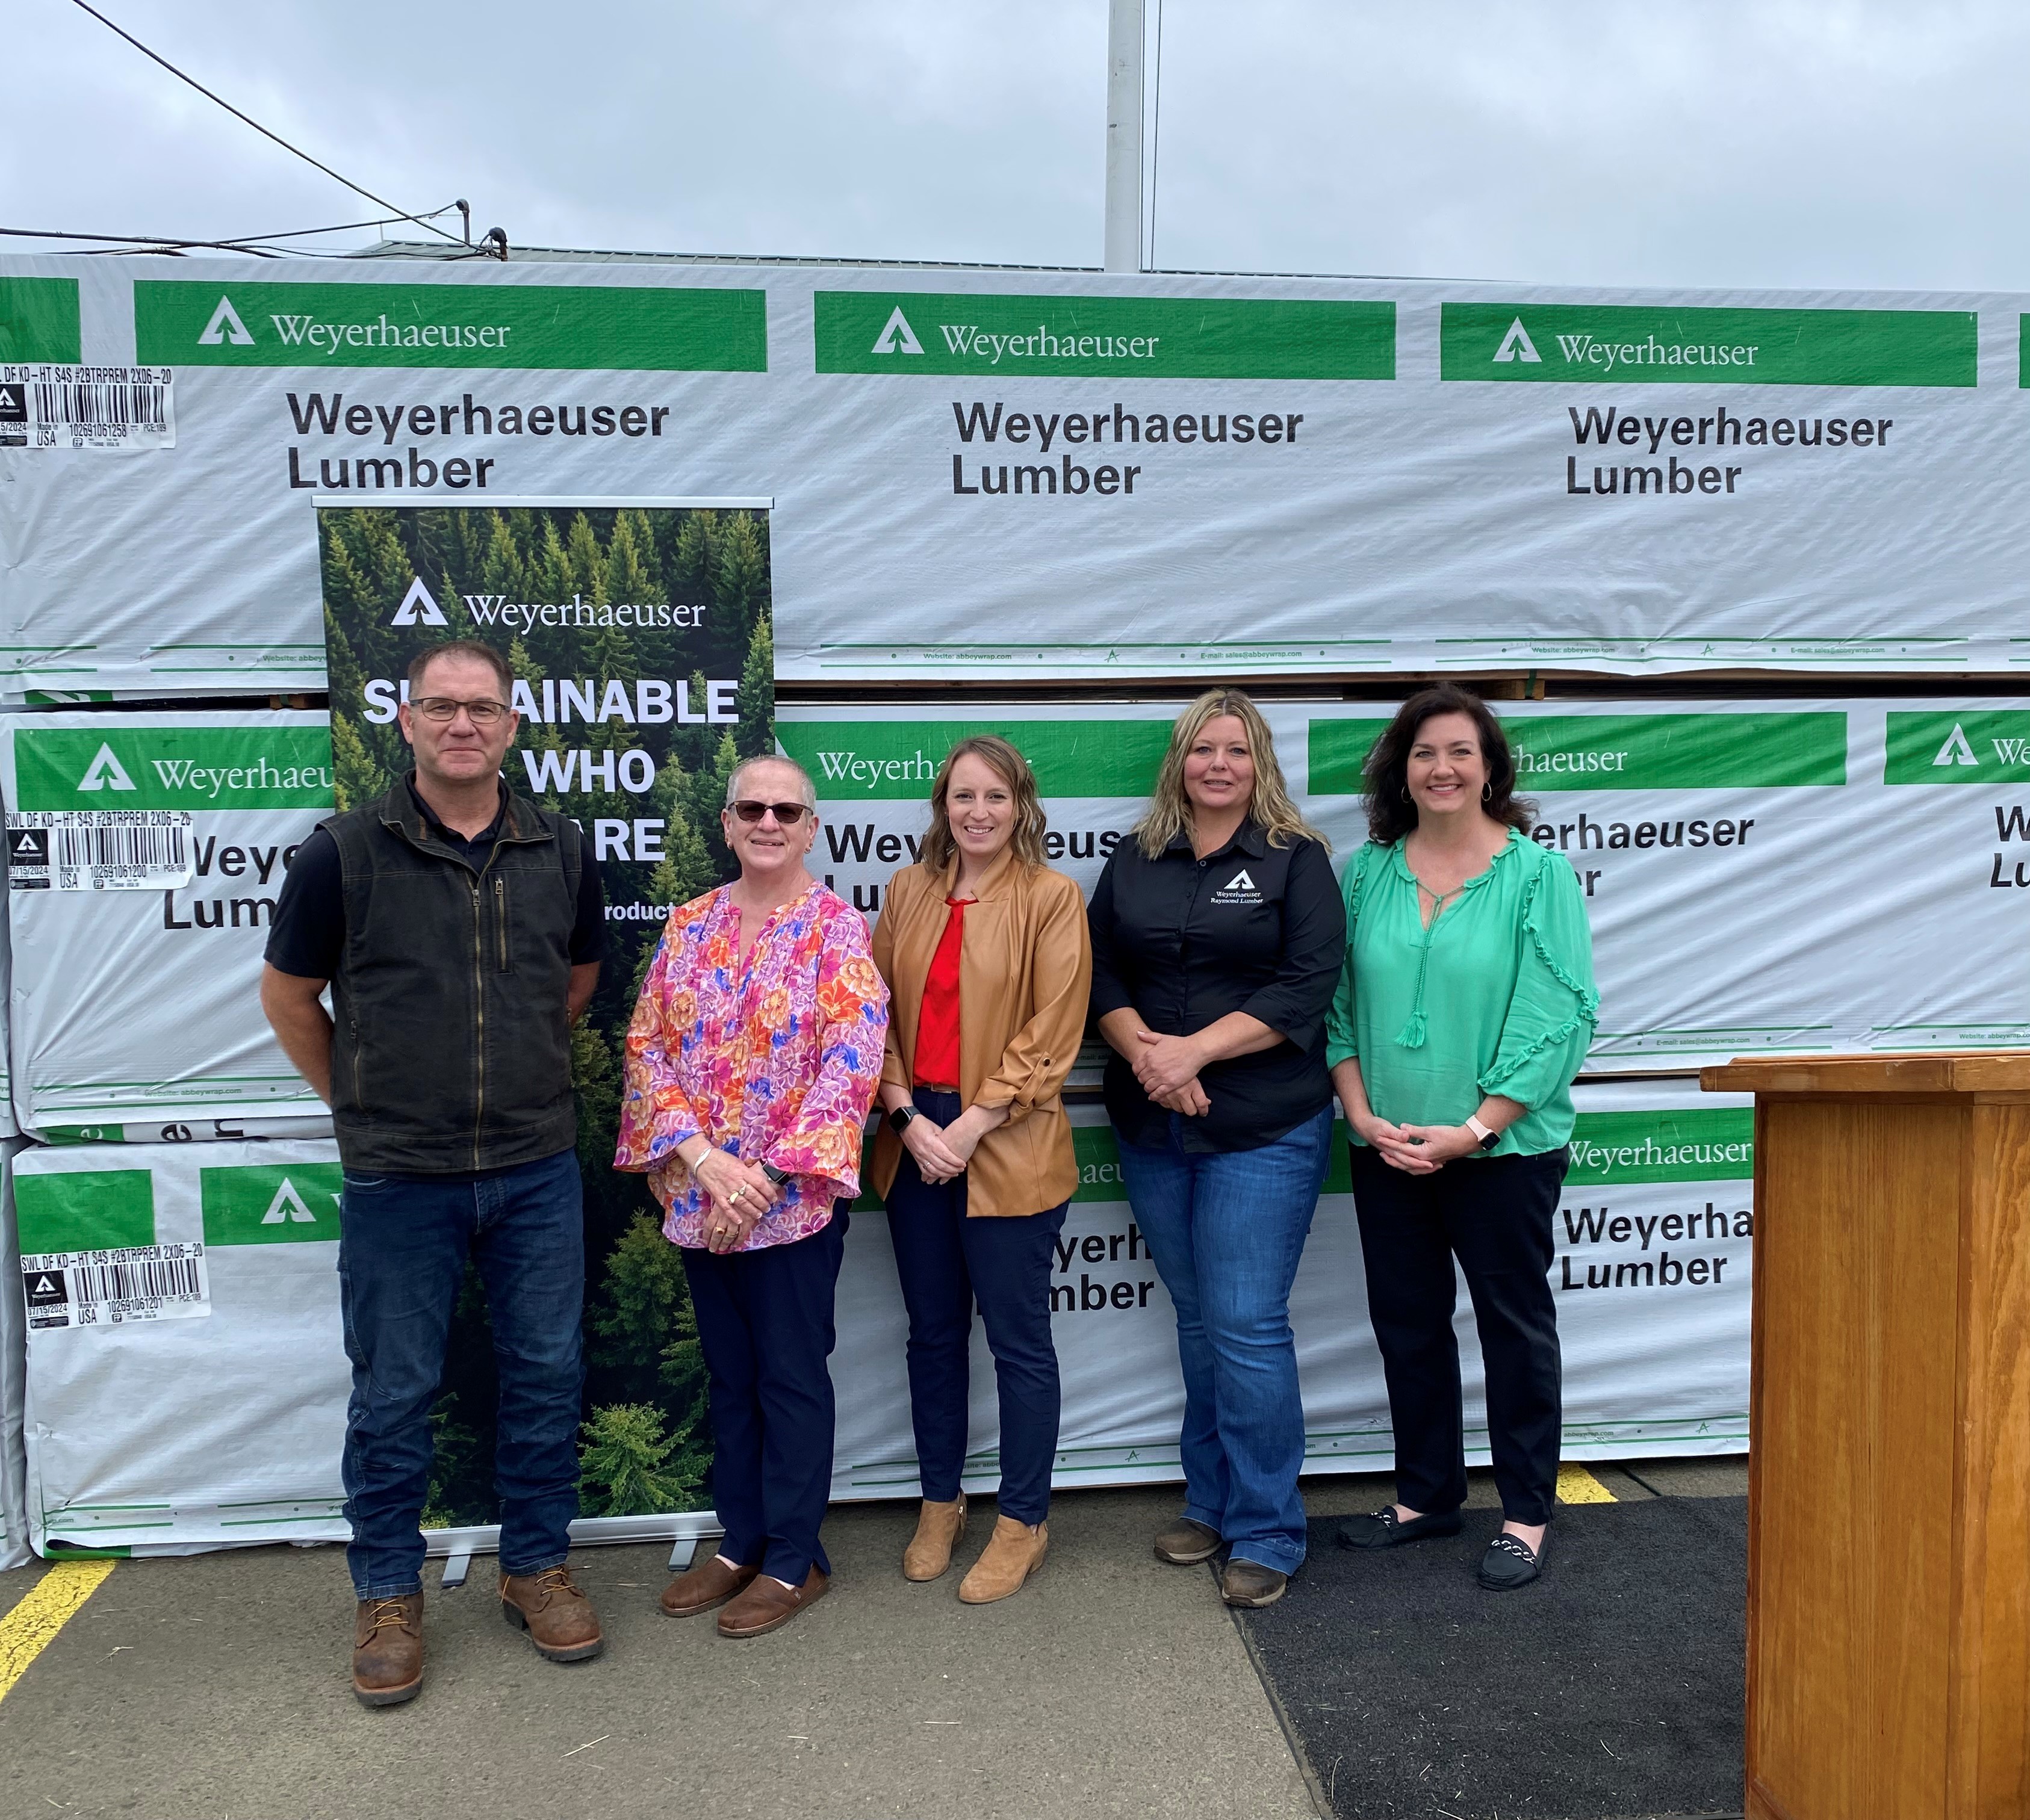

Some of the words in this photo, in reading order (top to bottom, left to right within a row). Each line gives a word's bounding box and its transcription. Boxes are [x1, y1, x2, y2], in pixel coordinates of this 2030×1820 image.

[270, 314, 511, 355] Weyerhaeuser
[939, 323, 1159, 365] Weyerhaeuser
[1556, 332, 1758, 373] Weyerhaeuser
[4, 366, 16, 382] DF
[55, 366, 72, 383] S4S
[75, 367, 128, 384] #2BTRPREM
[69, 423, 126, 437] 102691061258
[286, 392, 670, 445] Weyerhaeuser
[952, 402, 1304, 453] Weyerhaeuser
[1568, 406, 1894, 454] Weyerhaeuser
[37, 431, 57, 446] USA
[288, 447, 494, 489] Lumber
[952, 454, 1141, 495] Lumber
[1566, 456, 1742, 495] Lumber
[463, 593, 706, 636] Weyerhaeuser
[362, 679, 740, 725] SAINABLE
[521, 749, 655, 794] WHO
[1512, 744, 1628, 772] haeuser
[6, 812, 24, 828] SWL
[27, 812, 38, 828] DF
[77, 812, 93, 827] S4S
[8, 866, 48, 875] 07/15/2024
[60, 873, 78, 888] USA
[90, 865, 147, 878] 102691061200
[1568, 1137, 1753, 1174] Weyerhaeuser
[21, 1255, 41, 1271] SWL
[42, 1255, 54, 1270] DF
[92, 1250, 108, 1265] S4S
[1561, 1252, 1728, 1291] Lumber
[27, 1304, 67, 1316] 07/15/2024
[78, 1308, 98, 1324] USA
[107, 1296, 163, 1313] 102691061201
